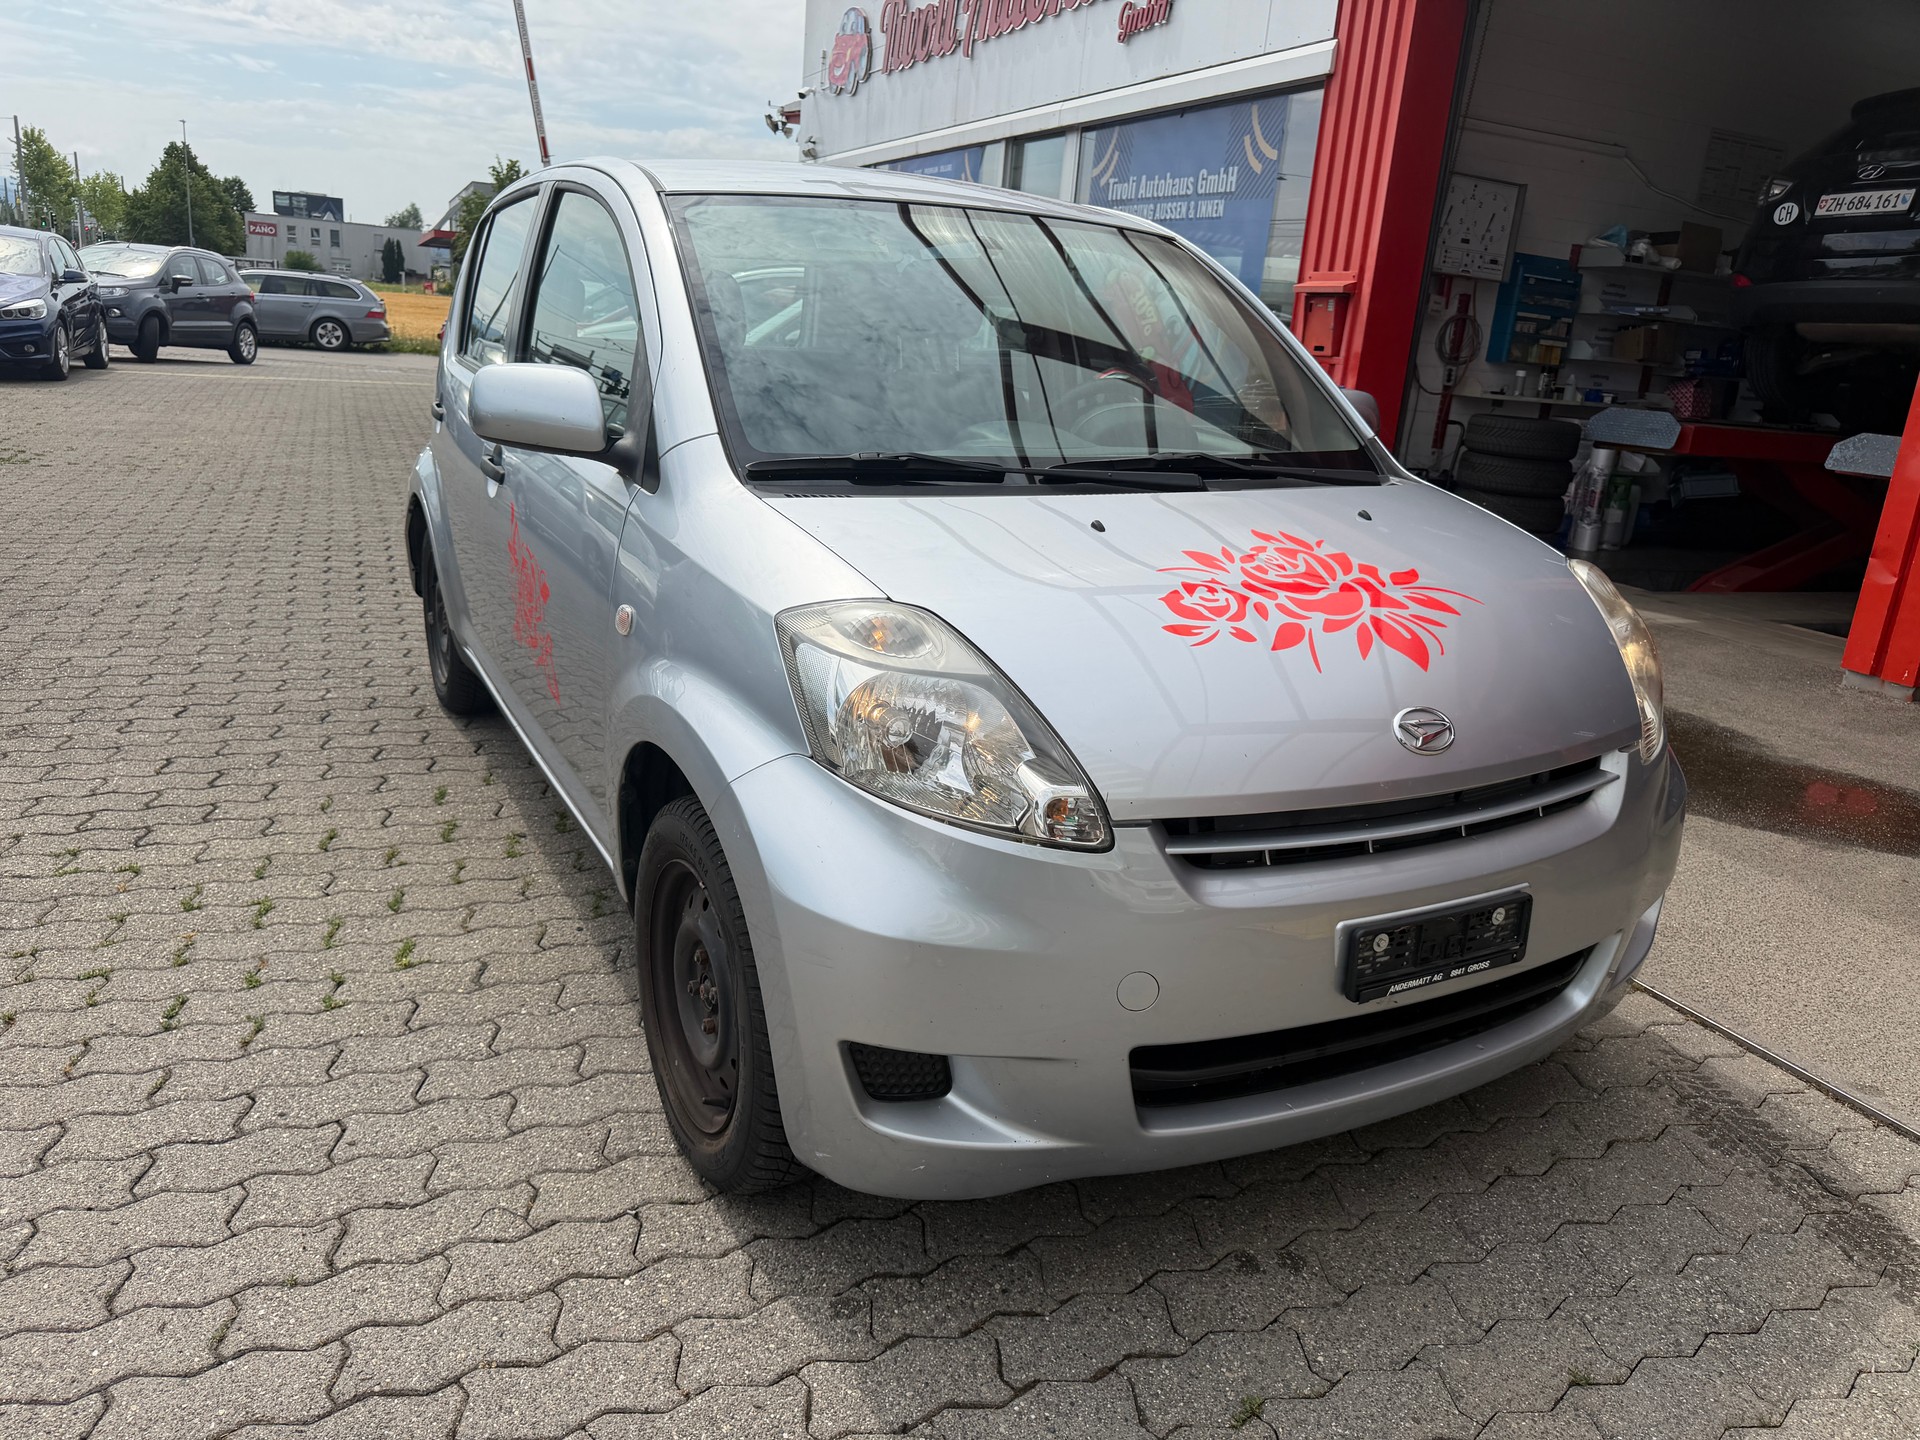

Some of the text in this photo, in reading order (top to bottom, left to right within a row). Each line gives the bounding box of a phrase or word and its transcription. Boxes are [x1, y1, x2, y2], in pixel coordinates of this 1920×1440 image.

[1118, 0, 1170, 45] GmbH
[1108, 166, 1238, 200] Tivoli Autohaus GmbH
[1154, 201, 1187, 220] AUSSEN
[1188, 202, 1195, 218] &
[1196, 199, 1225, 218] INNEN
[1779, 205, 1794, 223] CH
[250, 225, 275, 235] PANO
[1387, 960, 1490, 996] ANDERMATT AG 8841 GROSS
